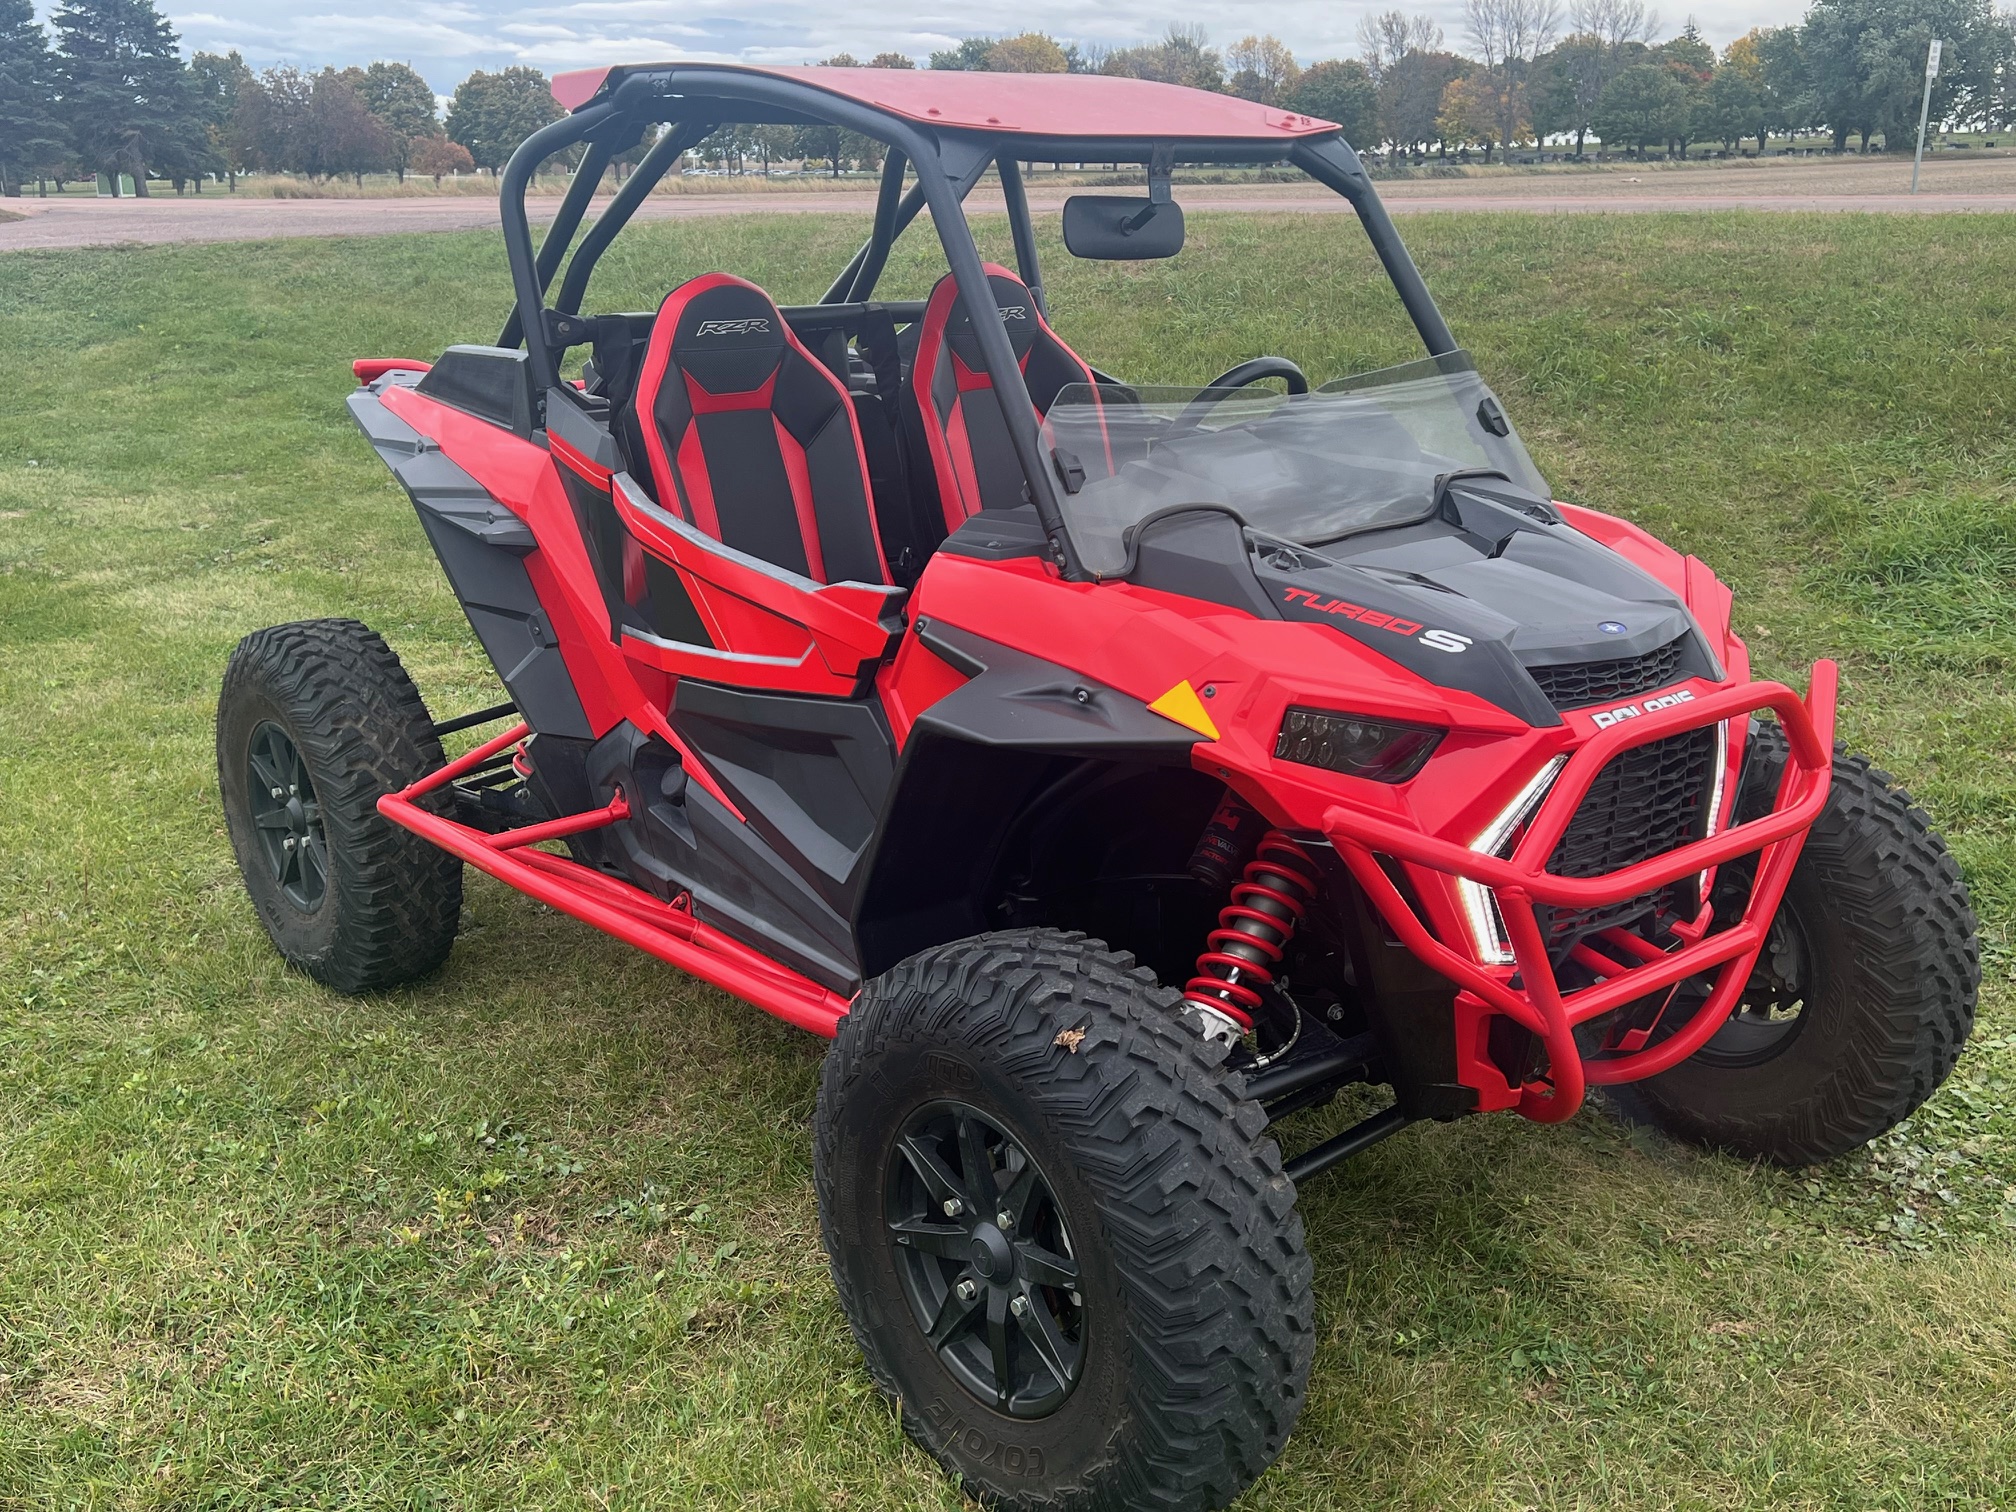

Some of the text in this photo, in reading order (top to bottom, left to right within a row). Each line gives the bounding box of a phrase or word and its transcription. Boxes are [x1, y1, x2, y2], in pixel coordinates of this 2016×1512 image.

[696, 318, 770, 336] RZR
[1284, 587, 1474, 653] TURBO S
[922, 1396, 1046, 1477] COYOTE
